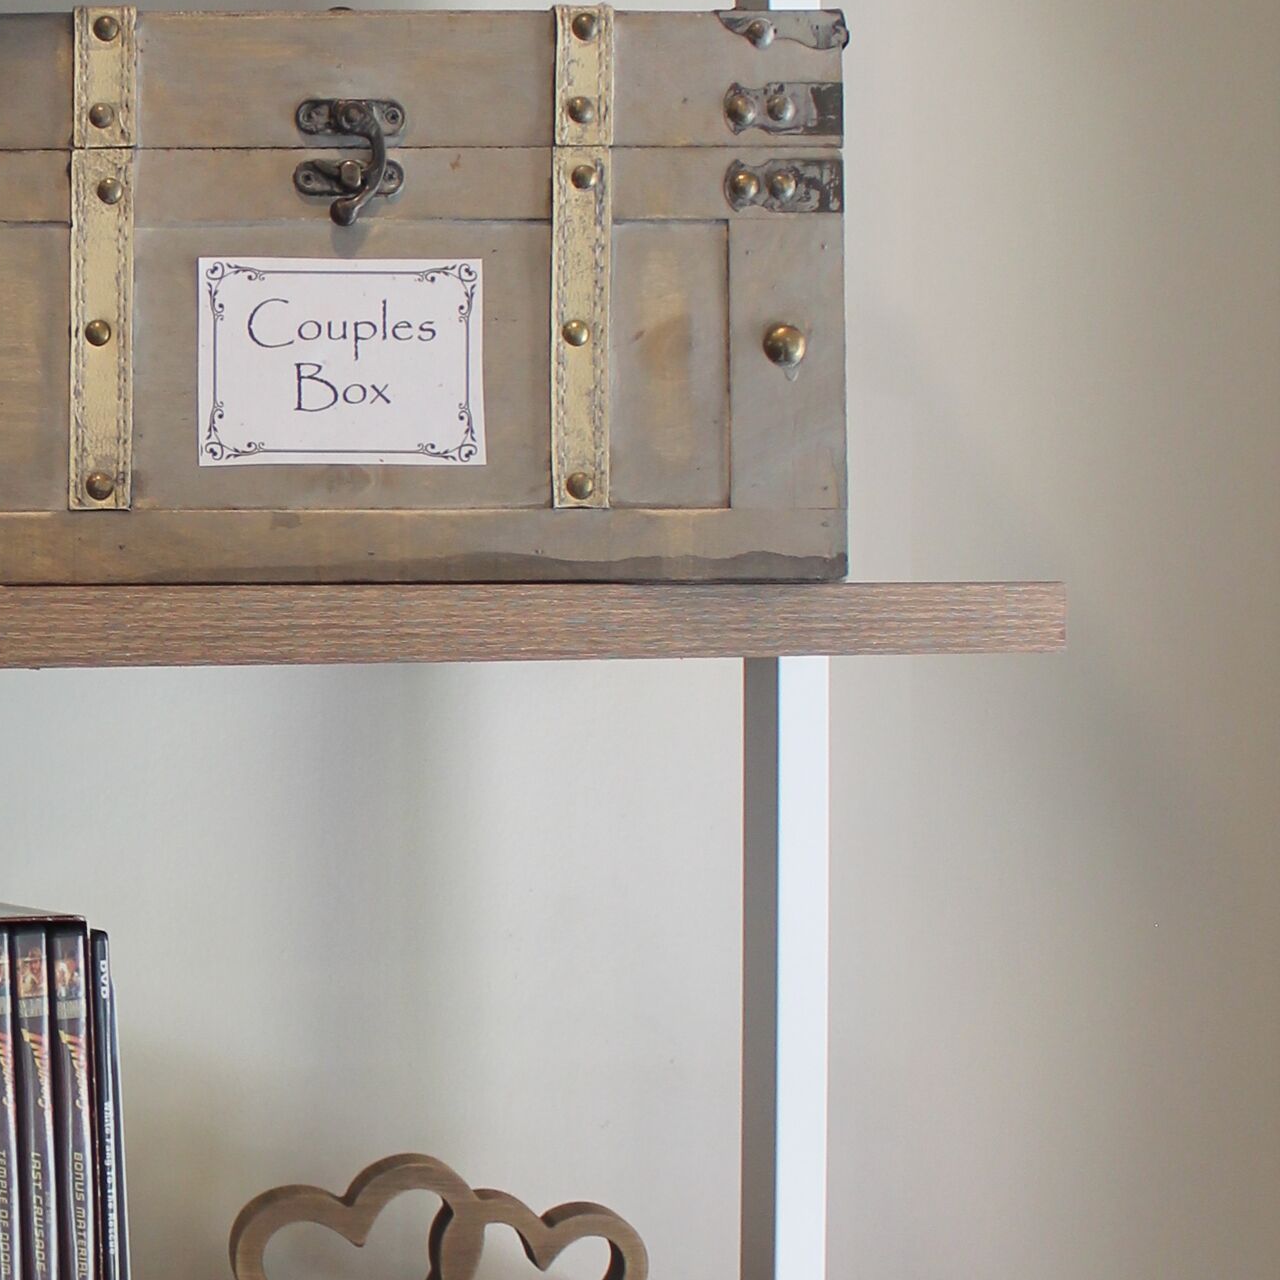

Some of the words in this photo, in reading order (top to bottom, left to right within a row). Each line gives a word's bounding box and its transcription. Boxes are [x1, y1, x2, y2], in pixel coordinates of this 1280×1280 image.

[247, 297, 438, 361] Couples
[293, 361, 392, 412] Box
[99, 959, 109, 999] DVD
[30, 1152, 43, 1193] LAST
[73, 1151, 87, 1201] BONUS
[0, 1209, 10, 1229] OF
[33, 1194, 47, 1273] CRUSADE
[75, 1206, 89, 1279] MATERIAL
[0, 1231, 12, 1276] DOOM
